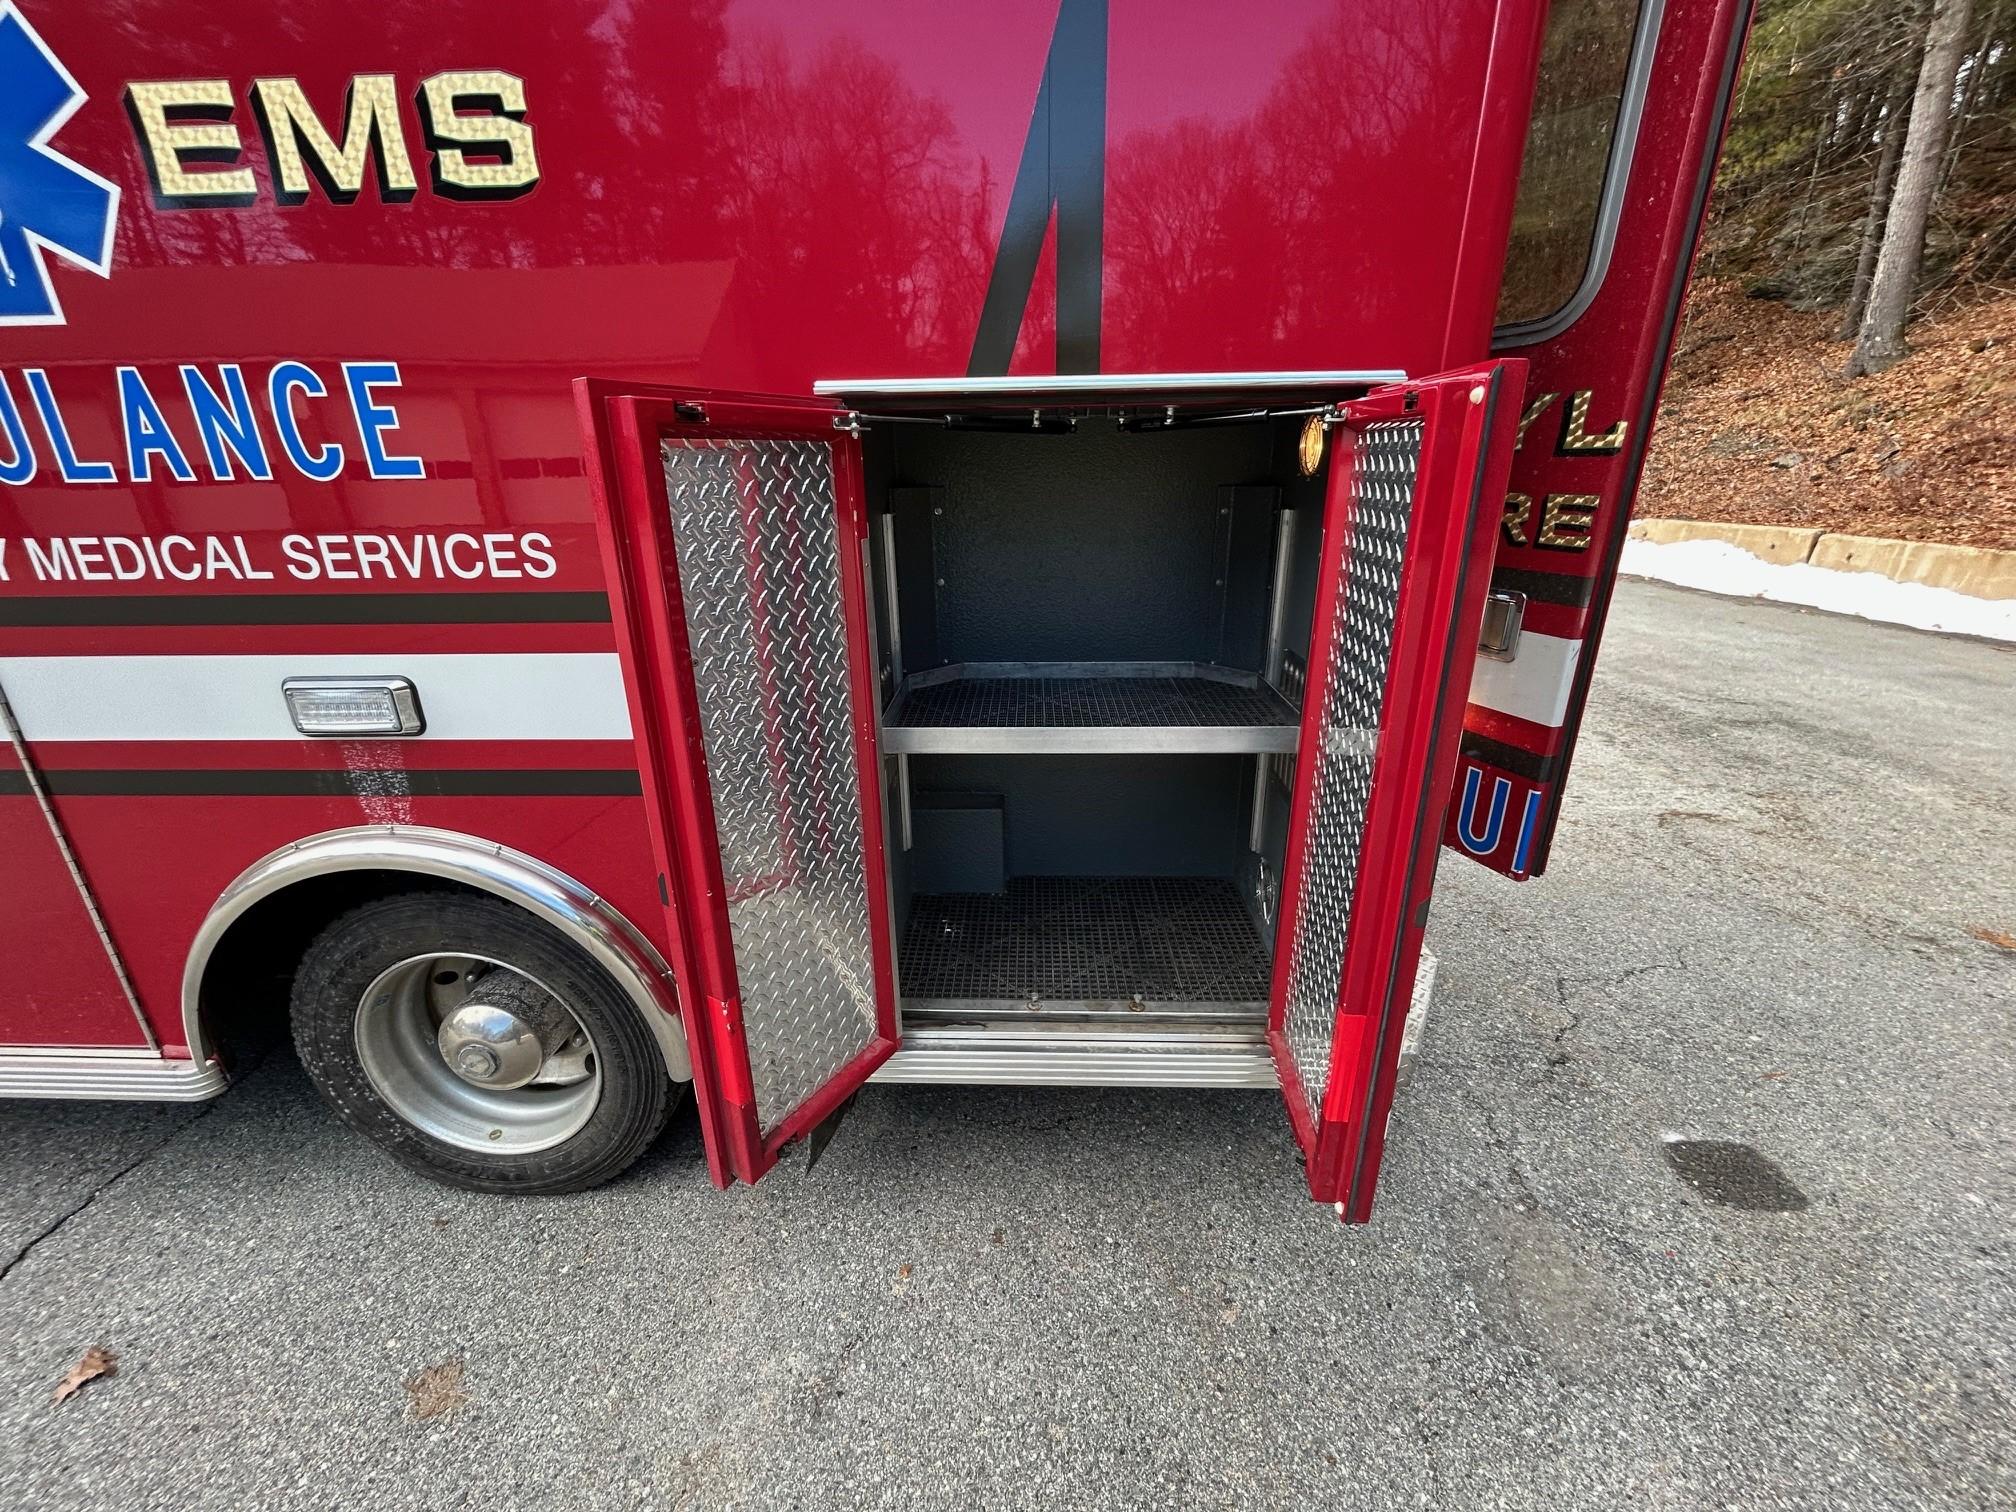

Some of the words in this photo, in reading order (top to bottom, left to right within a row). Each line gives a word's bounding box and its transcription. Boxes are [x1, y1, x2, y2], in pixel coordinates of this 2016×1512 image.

[123, 70, 540, 209] EMS
[23, 534, 274, 581] MEDICAL
[282, 532, 557, 580] SERVICES
